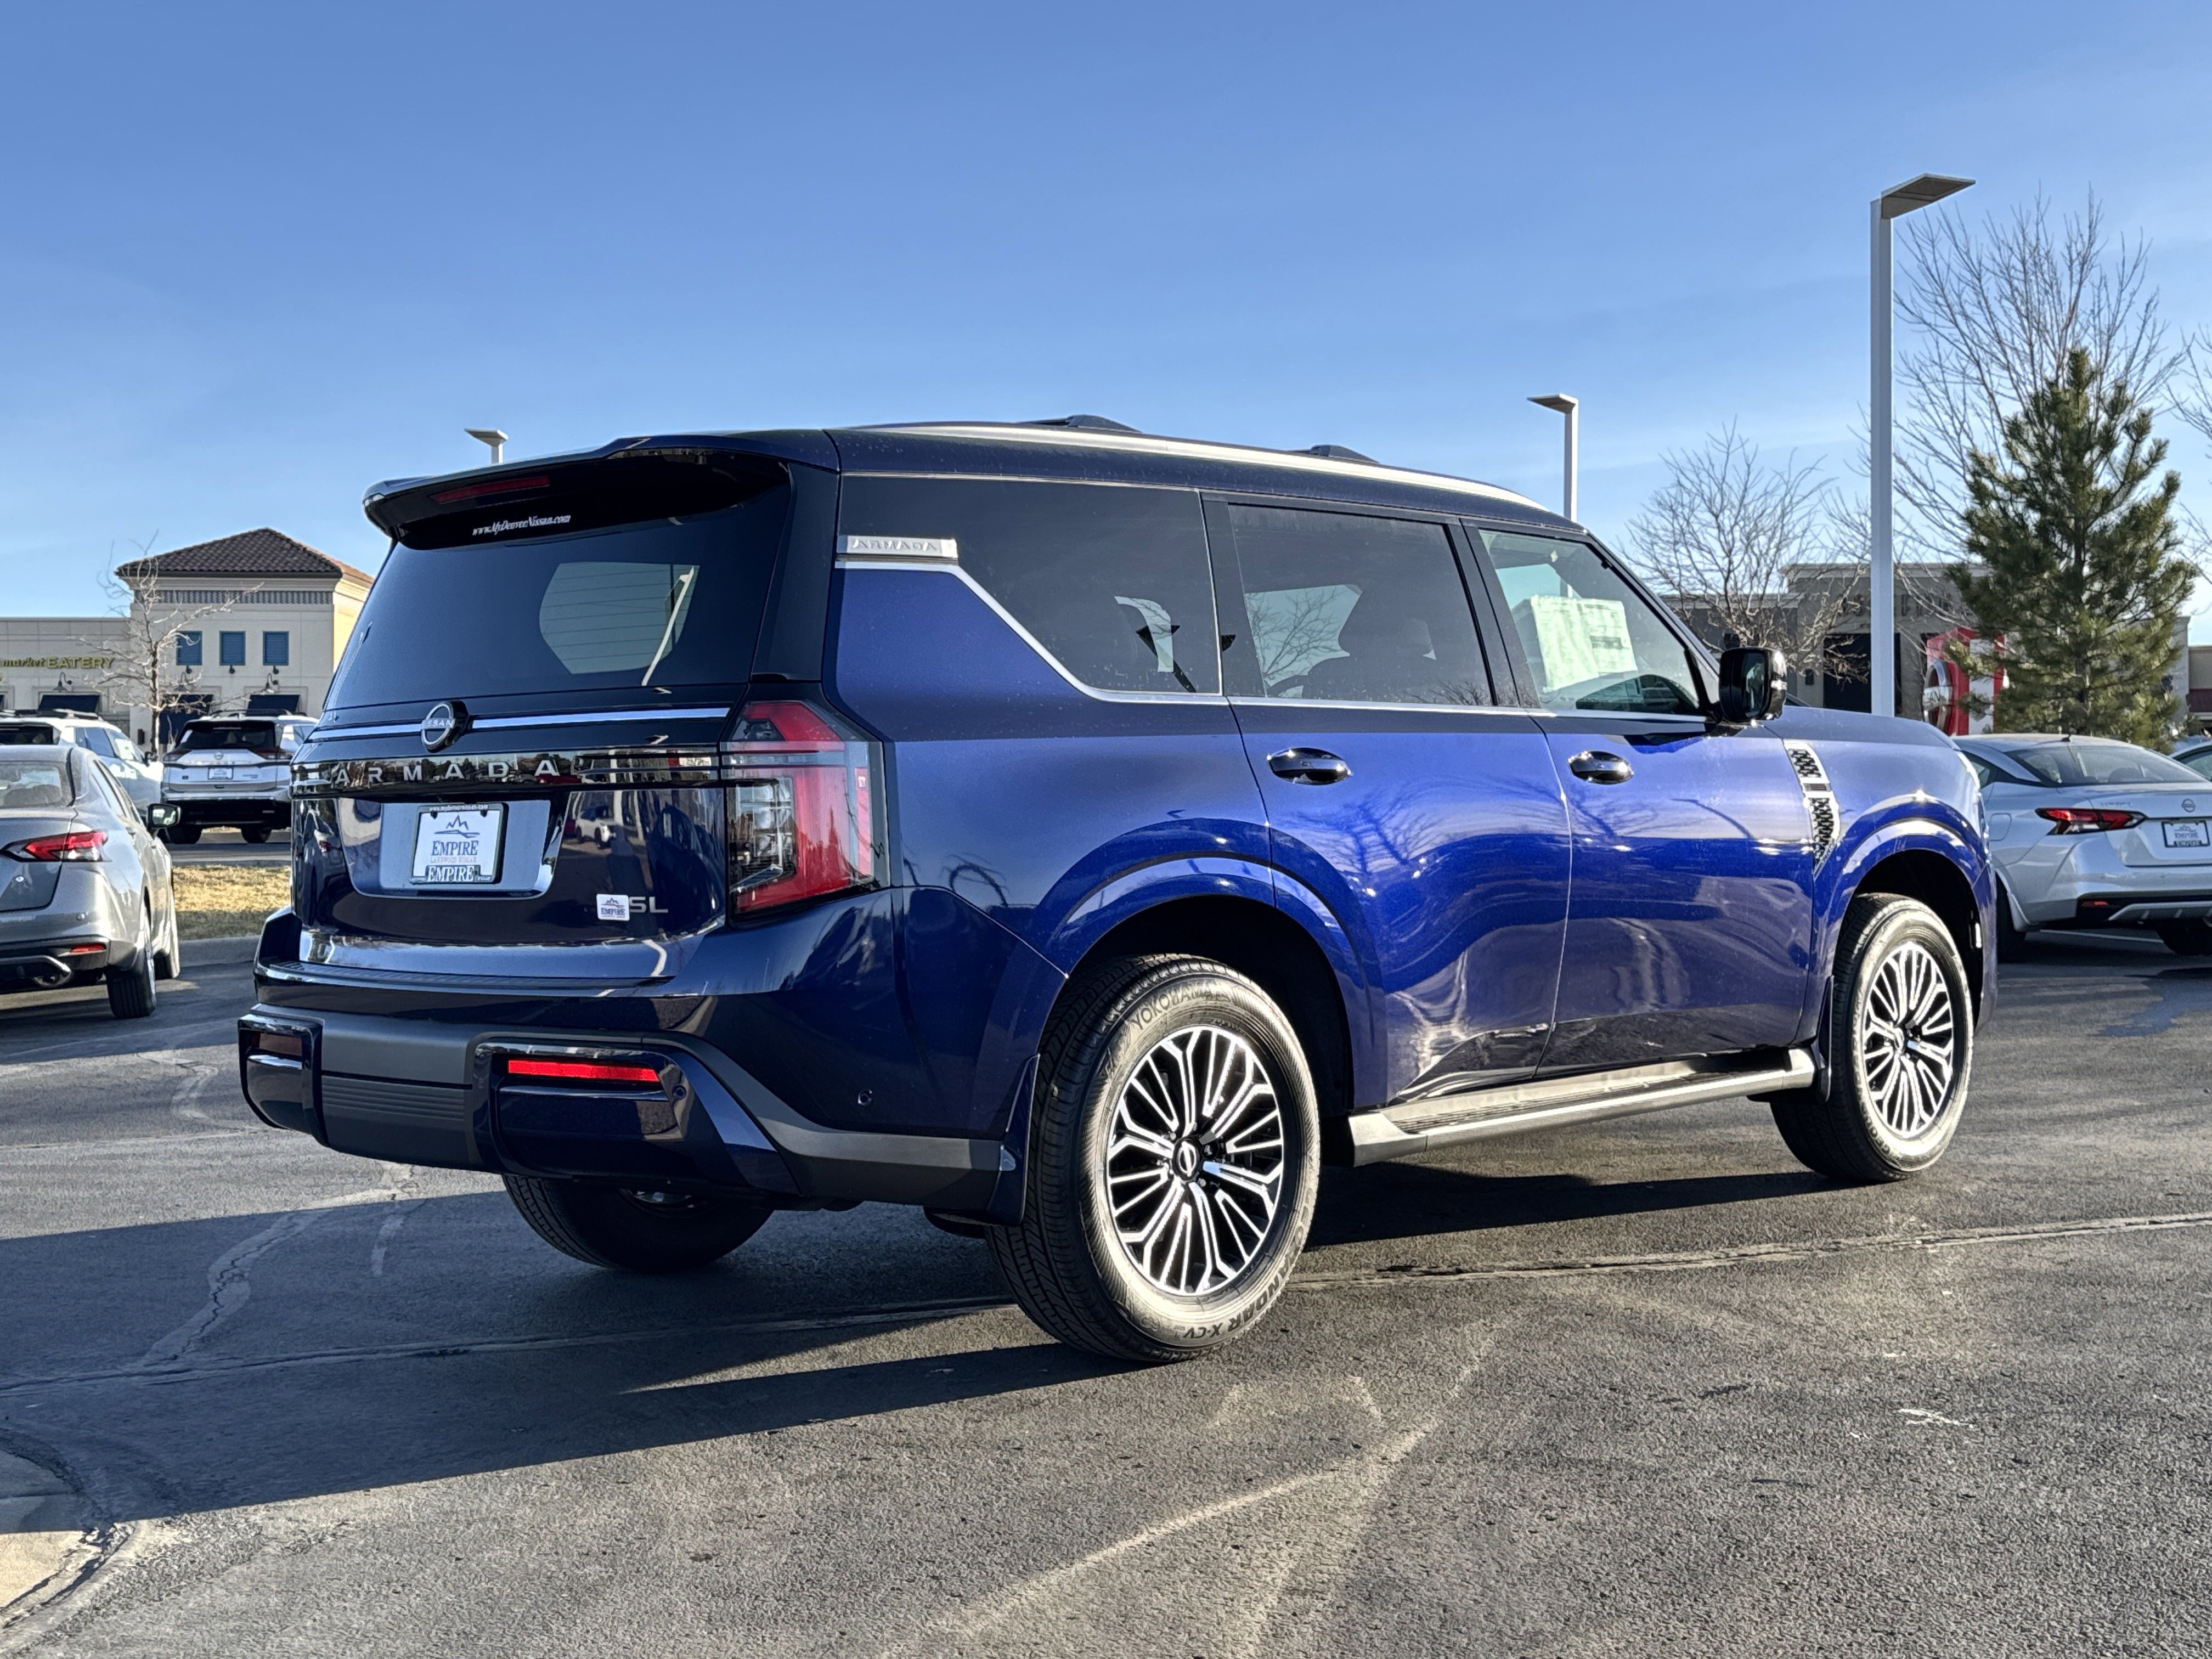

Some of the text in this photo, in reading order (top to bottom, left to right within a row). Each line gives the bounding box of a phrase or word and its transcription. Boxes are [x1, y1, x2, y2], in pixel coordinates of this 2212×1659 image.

[853, 539, 938, 551] ARMADA
[47, 657, 115, 669] EATERY
[335, 759, 560, 785] ARMADA
[431, 840, 479, 856] EMPIRE
[426, 865, 475, 882] EMPIRE
[629, 896, 669, 913] SL
